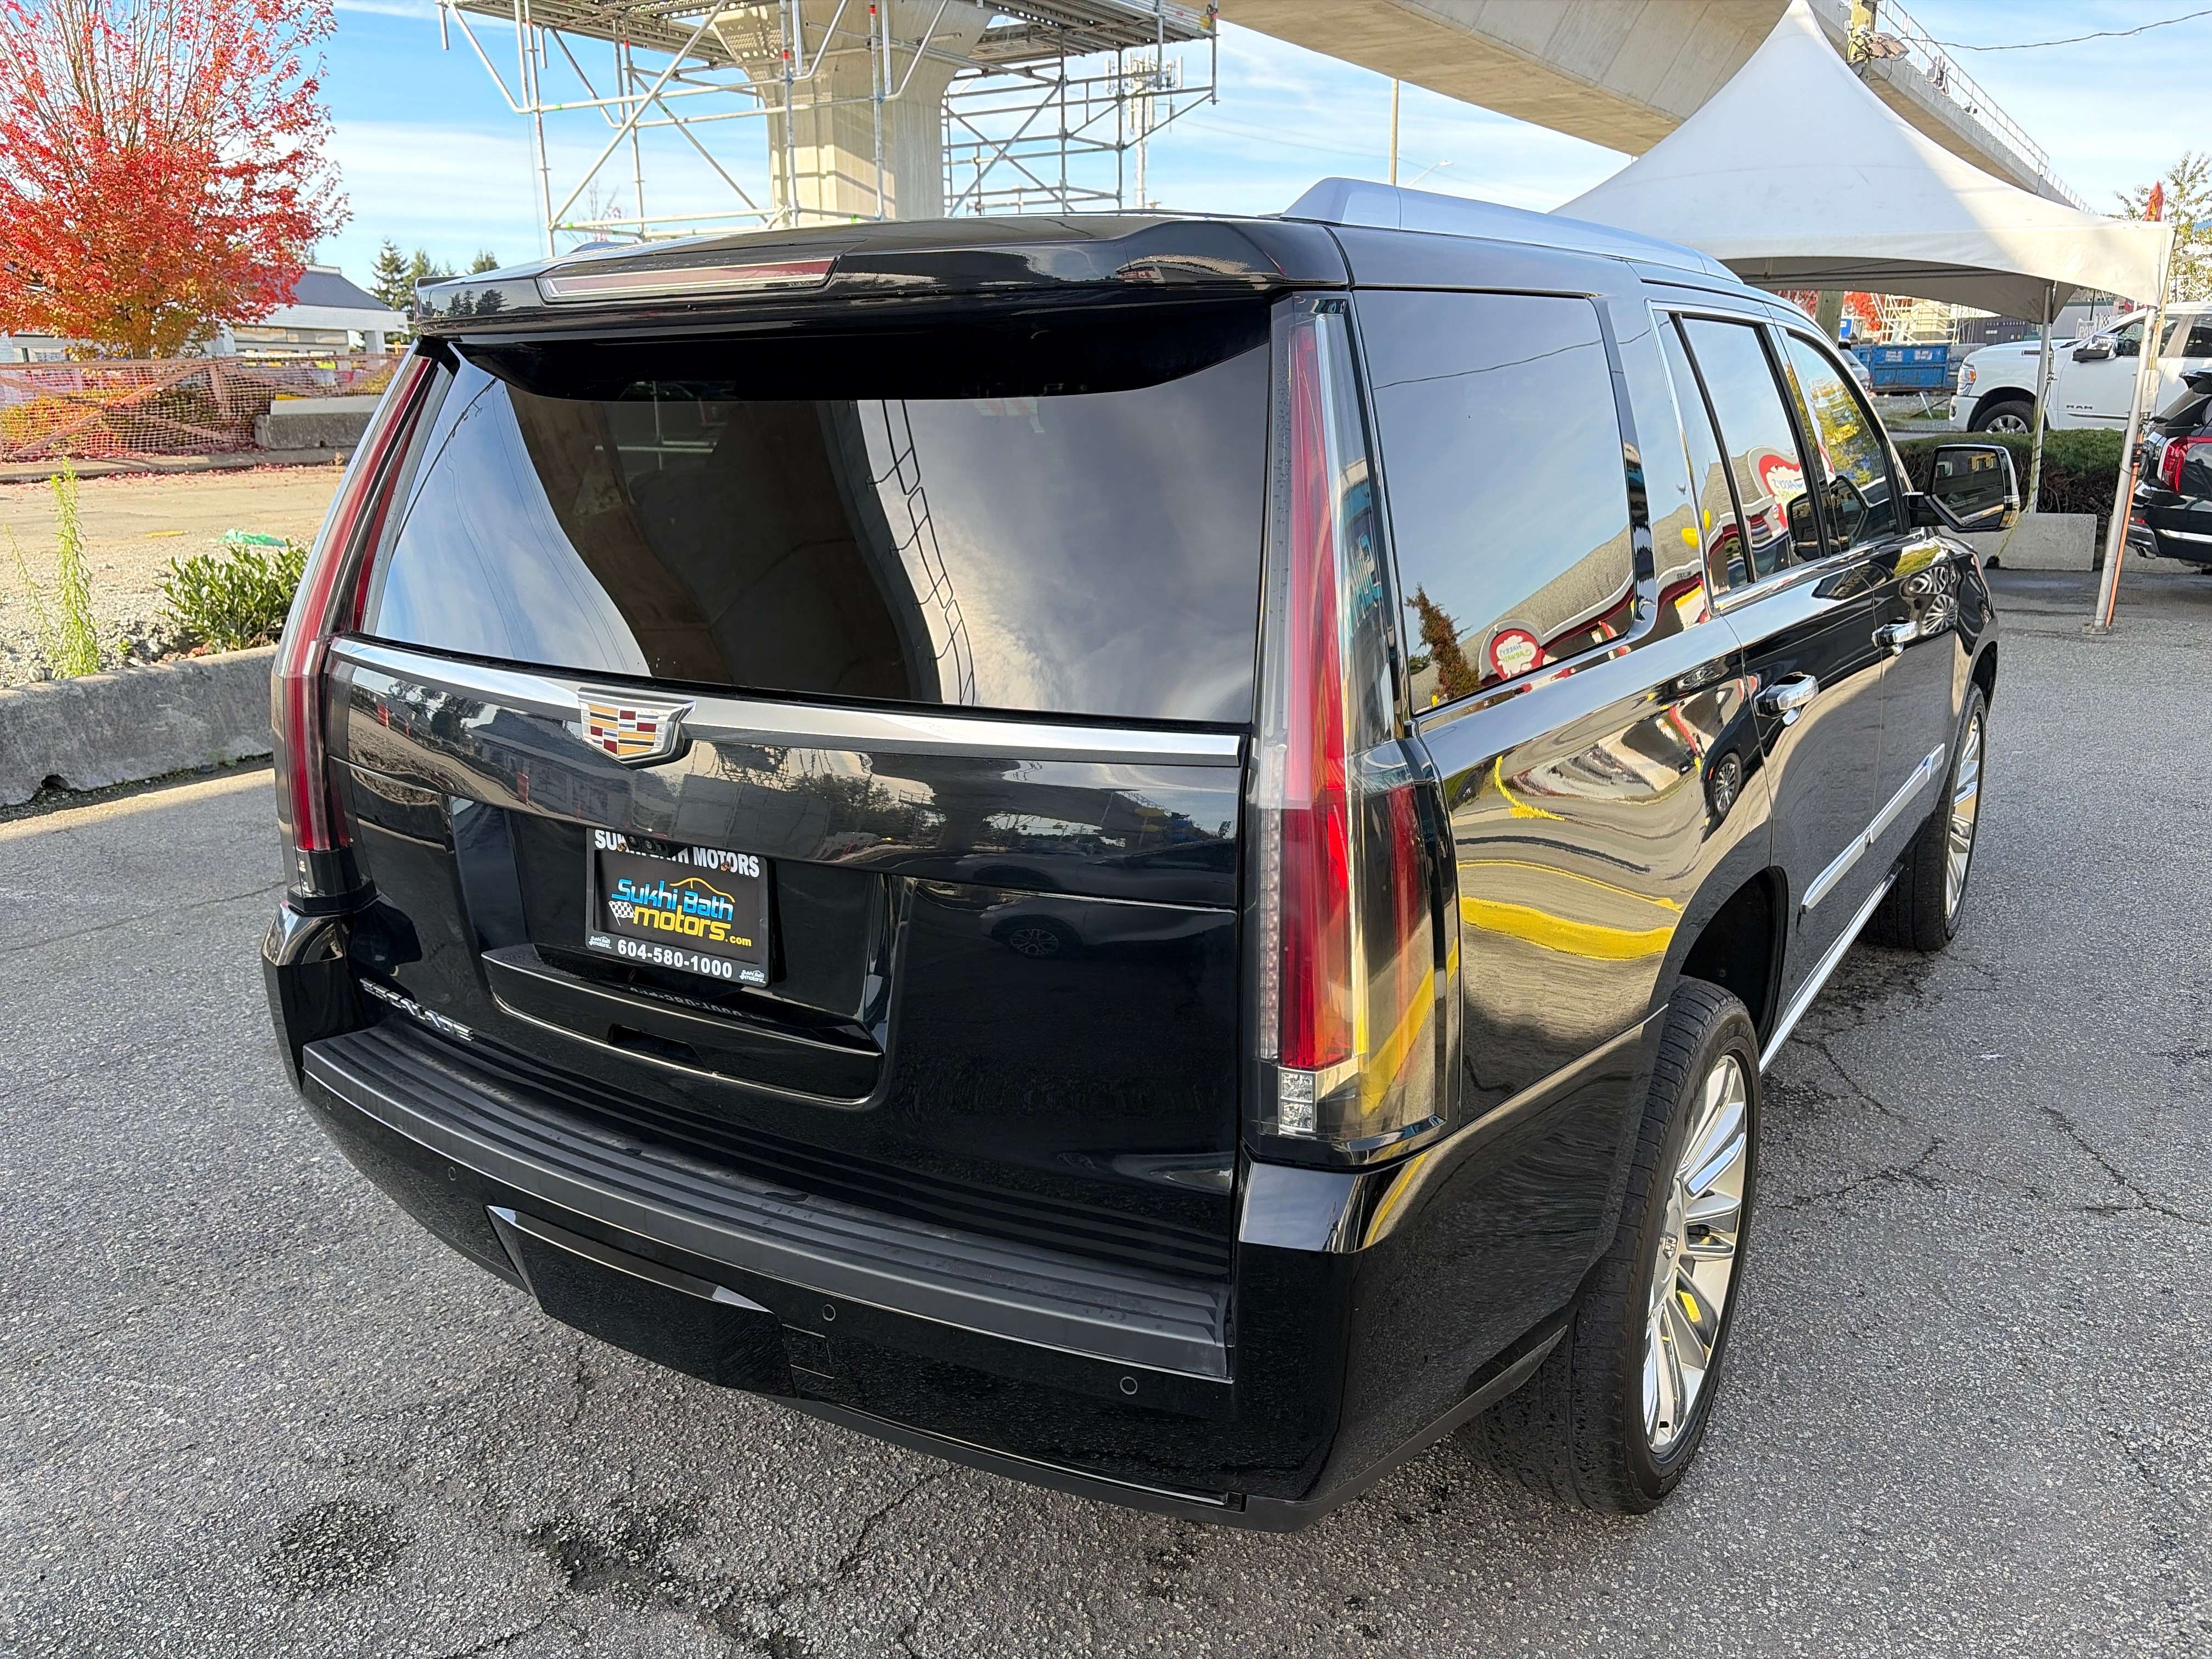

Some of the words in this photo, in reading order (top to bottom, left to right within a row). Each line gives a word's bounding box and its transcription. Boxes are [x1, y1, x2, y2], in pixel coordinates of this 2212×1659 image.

[693, 847, 760, 878] MOTORS
[611, 878, 678, 909] Sukhi
[683, 890, 733, 921] Bath
[633, 905, 752, 947] motors.com
[617, 939, 733, 979] 604-580-1000
